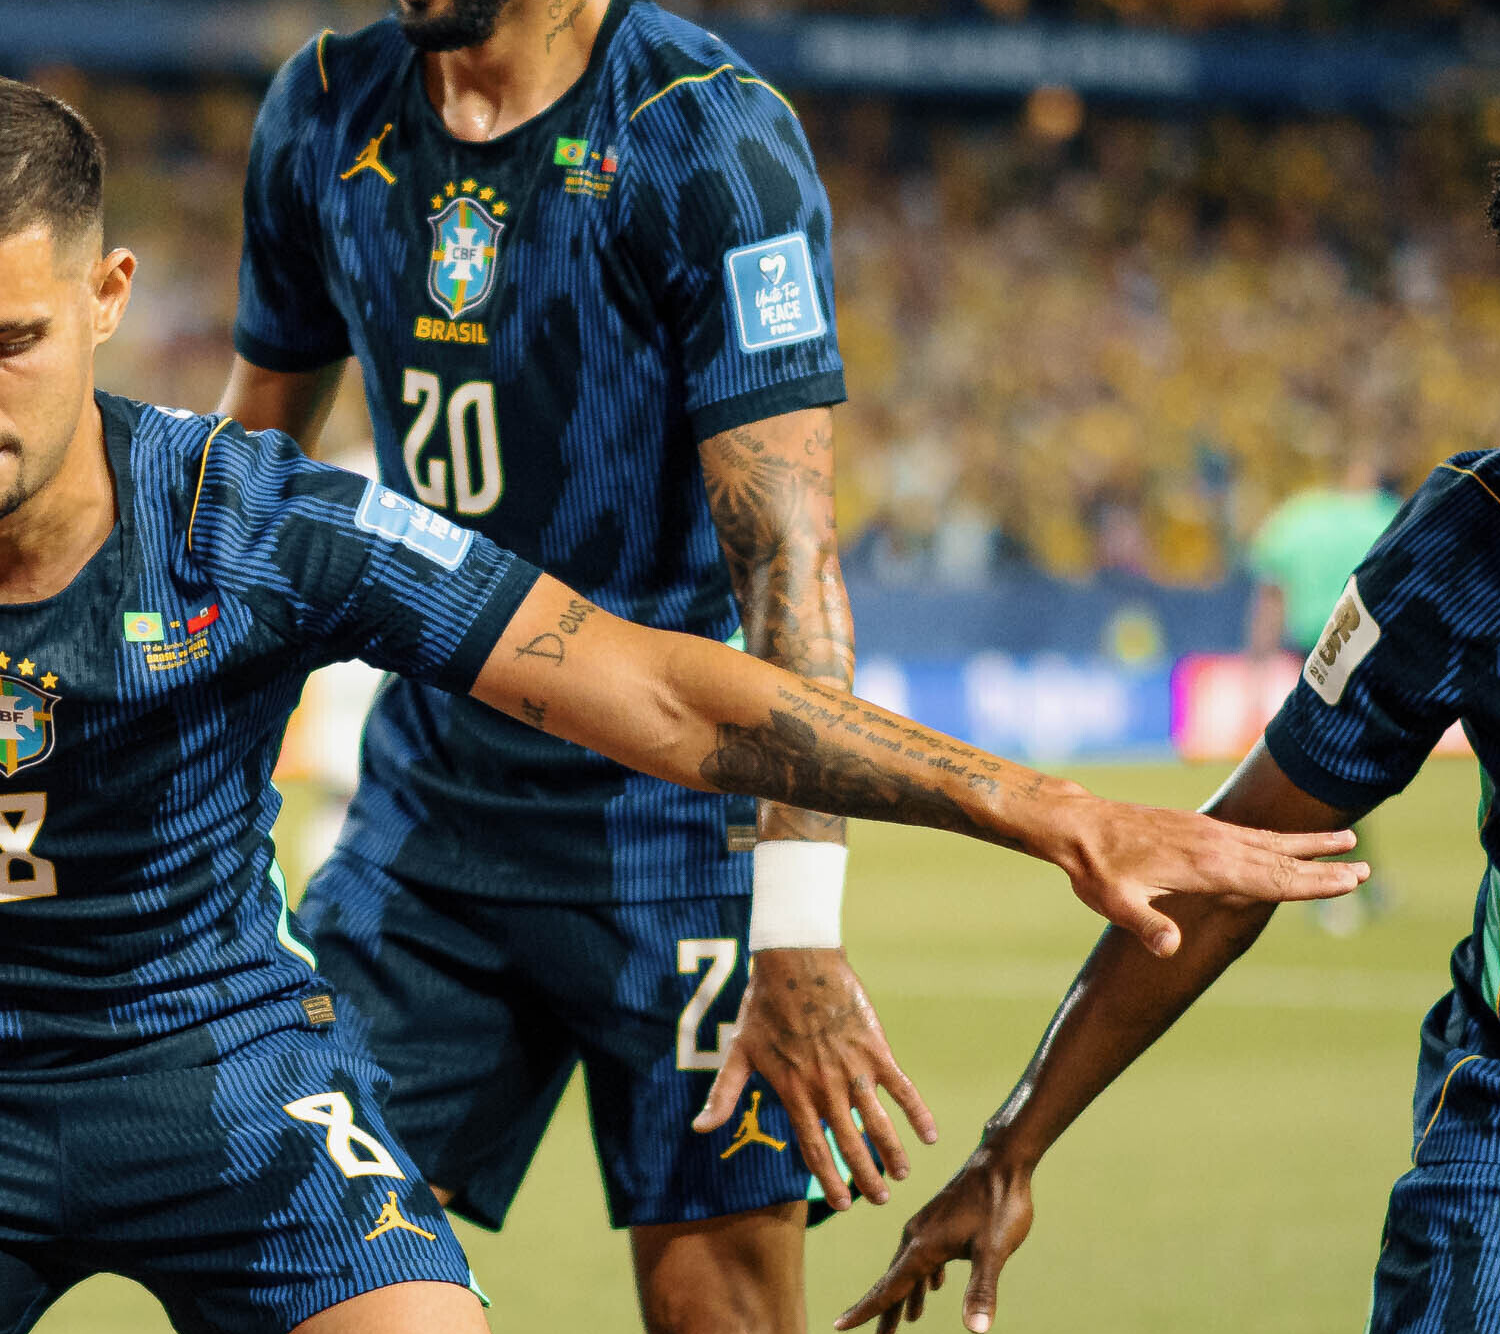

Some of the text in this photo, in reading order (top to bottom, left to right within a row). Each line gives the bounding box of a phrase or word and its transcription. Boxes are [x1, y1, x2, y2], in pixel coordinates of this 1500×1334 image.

[452, 247, 477, 262] CBF
[760, 300, 802, 326] PEACE
[415, 317, 488, 346] BRASIL
[403, 368, 503, 516] 20
[143, 644, 151, 652] 19
[676, 938, 742, 1071] 2
[284, 1091, 404, 1179] 8
